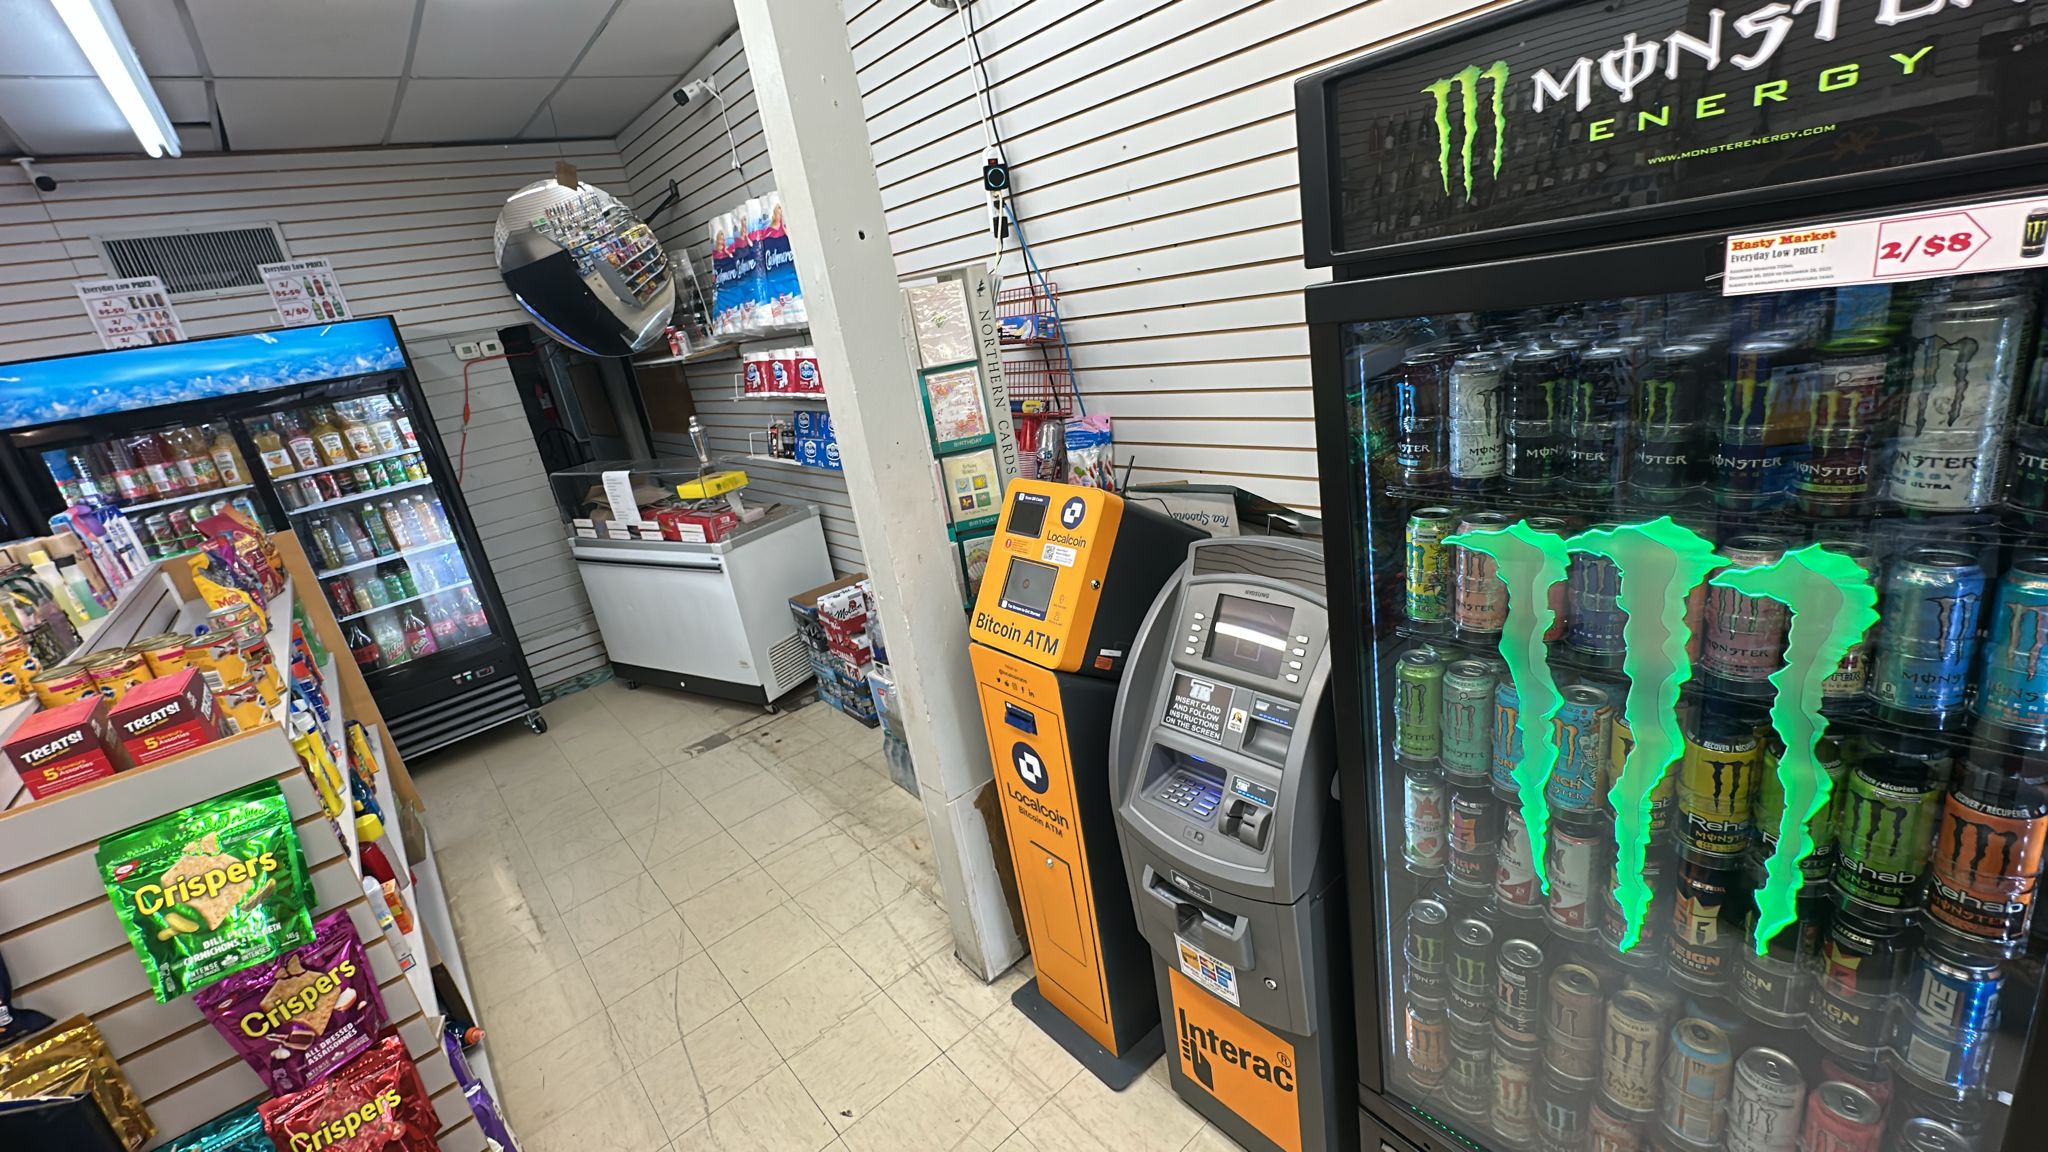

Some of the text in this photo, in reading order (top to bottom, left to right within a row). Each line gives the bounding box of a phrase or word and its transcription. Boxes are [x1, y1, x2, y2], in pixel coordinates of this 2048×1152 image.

[1588, 46, 1934, 143] ENERGY
[1730, 251, 1770, 263] Everyday
[1793, 245, 1819, 257] PRICE
[1731, 229, 1837, 251] Hasty Market
[1880, 230, 1973, 263] 2/$8
[978, 309, 1018, 475] NORTHERN CARDS
[953, 437, 984, 448] BIRTHDAY
[968, 517, 998, 527] BIRTHDAY
[1212, 516, 1231, 528] Tea
[1047, 531, 1087, 549] Localcoin
[976, 612, 1060, 656] Bitcoin ATM
[124, 701, 180, 733] TREATS!
[1173, 703, 1220, 723] AND FOLLOW
[1175, 695, 1221, 715] INSERT CARD
[1165, 716, 1176, 726] ON
[1176, 719, 1191, 731] THE
[1190, 723, 1221, 740] SCREEN
[1169, 709, 1220, 731] INSTRUCTIONS
[20, 730, 84, 763] TREATS!
[144, 738, 159, 750] 5
[43, 767, 59, 782] 5
[1007, 782, 1070, 829] Localcoin
[1018, 805, 1064, 838] Bitcoin ATM
[134, 851, 278, 916] Crispers
[202, 935, 225, 950] DILL
[240, 958, 357, 1038] Crispers
[304, 1022, 354, 1060] ALL DRESSED
[1179, 1007, 1294, 1093] Interac
[289, 1088, 402, 1152] Crispers
